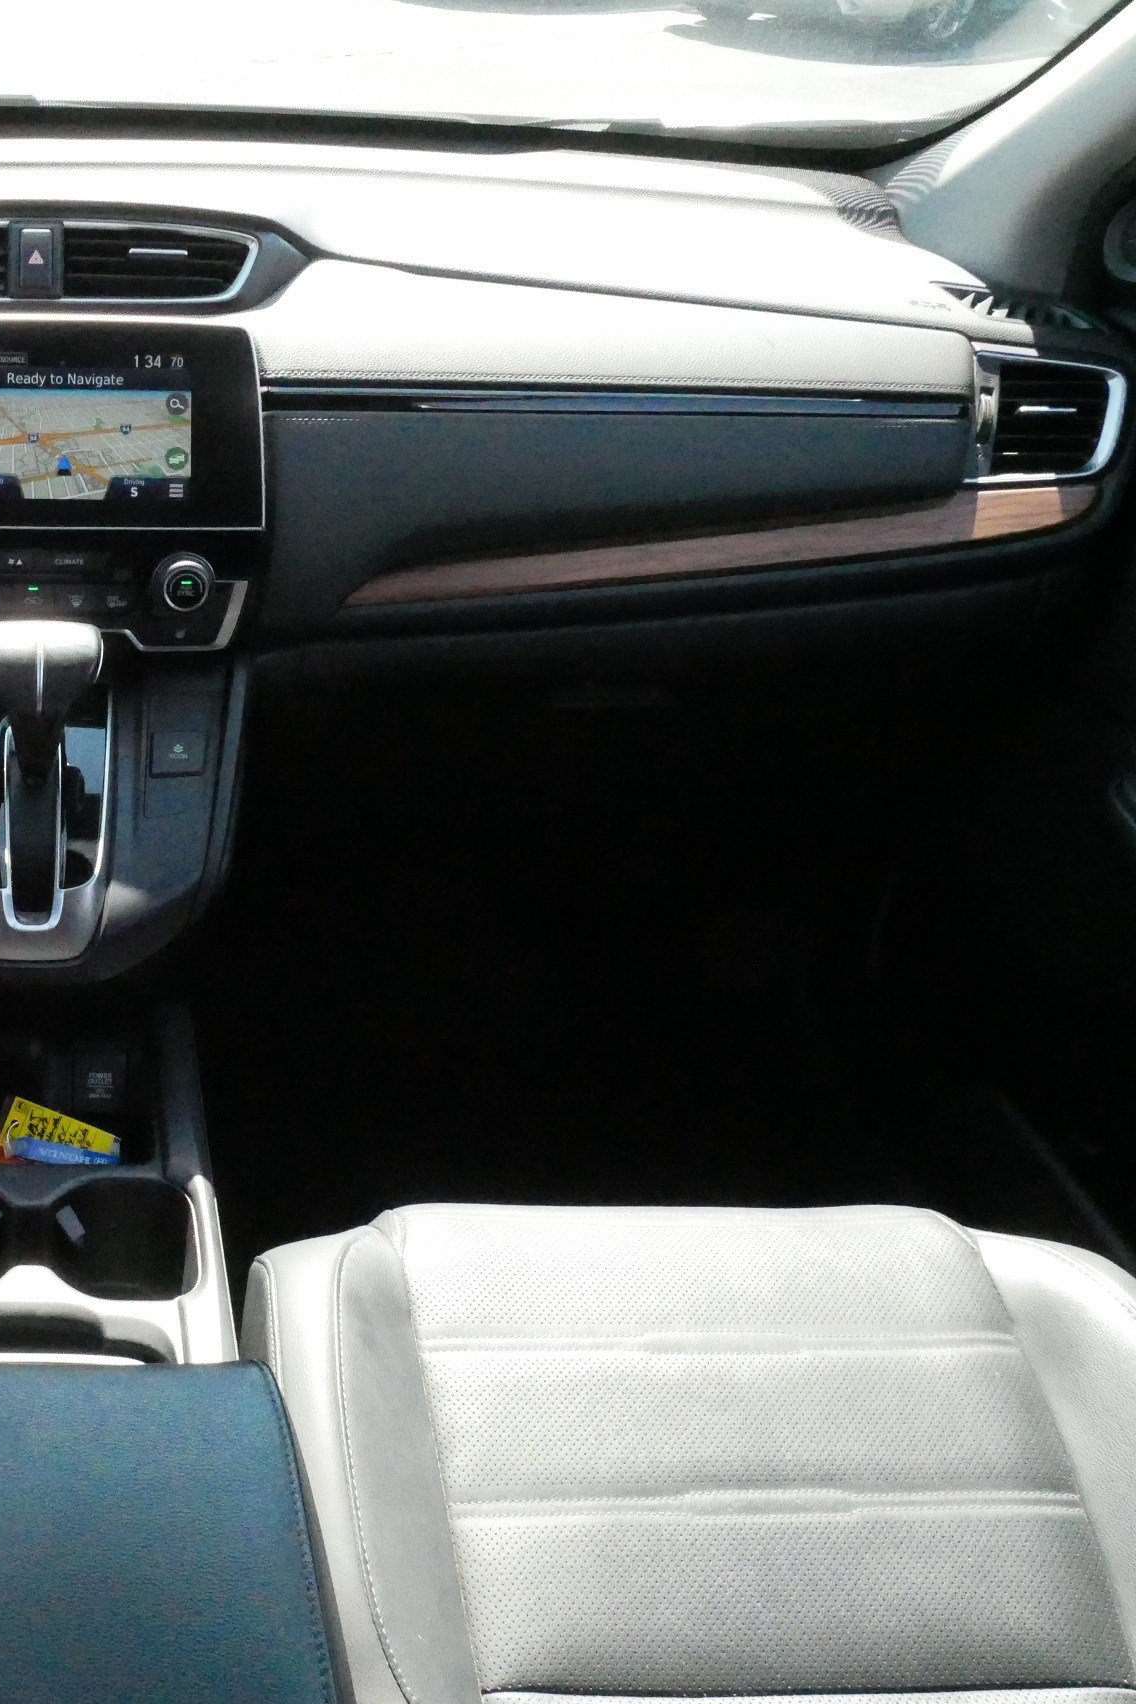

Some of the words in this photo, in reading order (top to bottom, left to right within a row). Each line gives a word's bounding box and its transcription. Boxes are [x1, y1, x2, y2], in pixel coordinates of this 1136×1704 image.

[0, 355, 26, 364] SOURCE
[169, 356, 184, 368] 70
[6, 373, 46, 387] Ready
[50, 373, 63, 385] to
[68, 373, 124, 387] Navigate
[123, 478, 145, 487] Driving
[130, 487, 138, 497] S
[55, 557, 85, 566] CLIMATE
